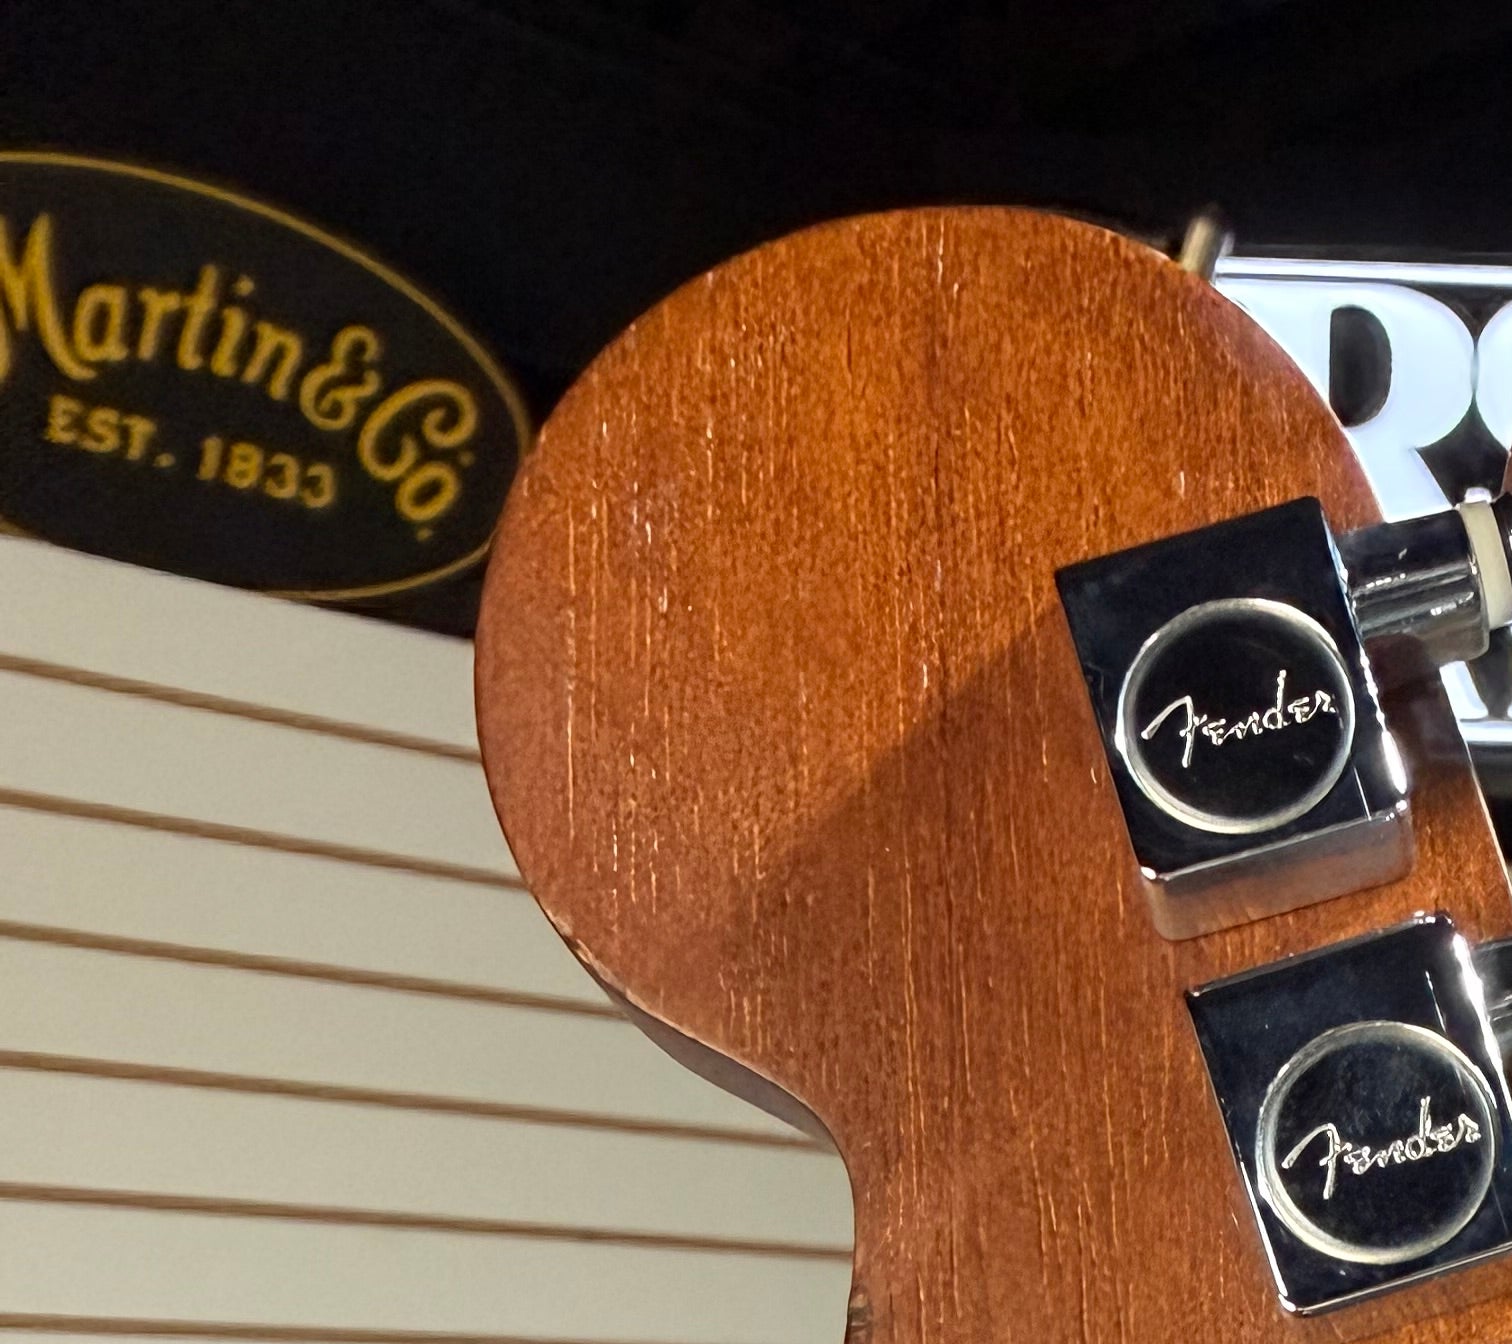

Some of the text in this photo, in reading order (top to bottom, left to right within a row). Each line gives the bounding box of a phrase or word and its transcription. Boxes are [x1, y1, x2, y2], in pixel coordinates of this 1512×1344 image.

[46, 395, 176, 468] EST.
[1141, 669, 1336, 768] Fender
[1282, 1096, 1482, 1200] Fender
